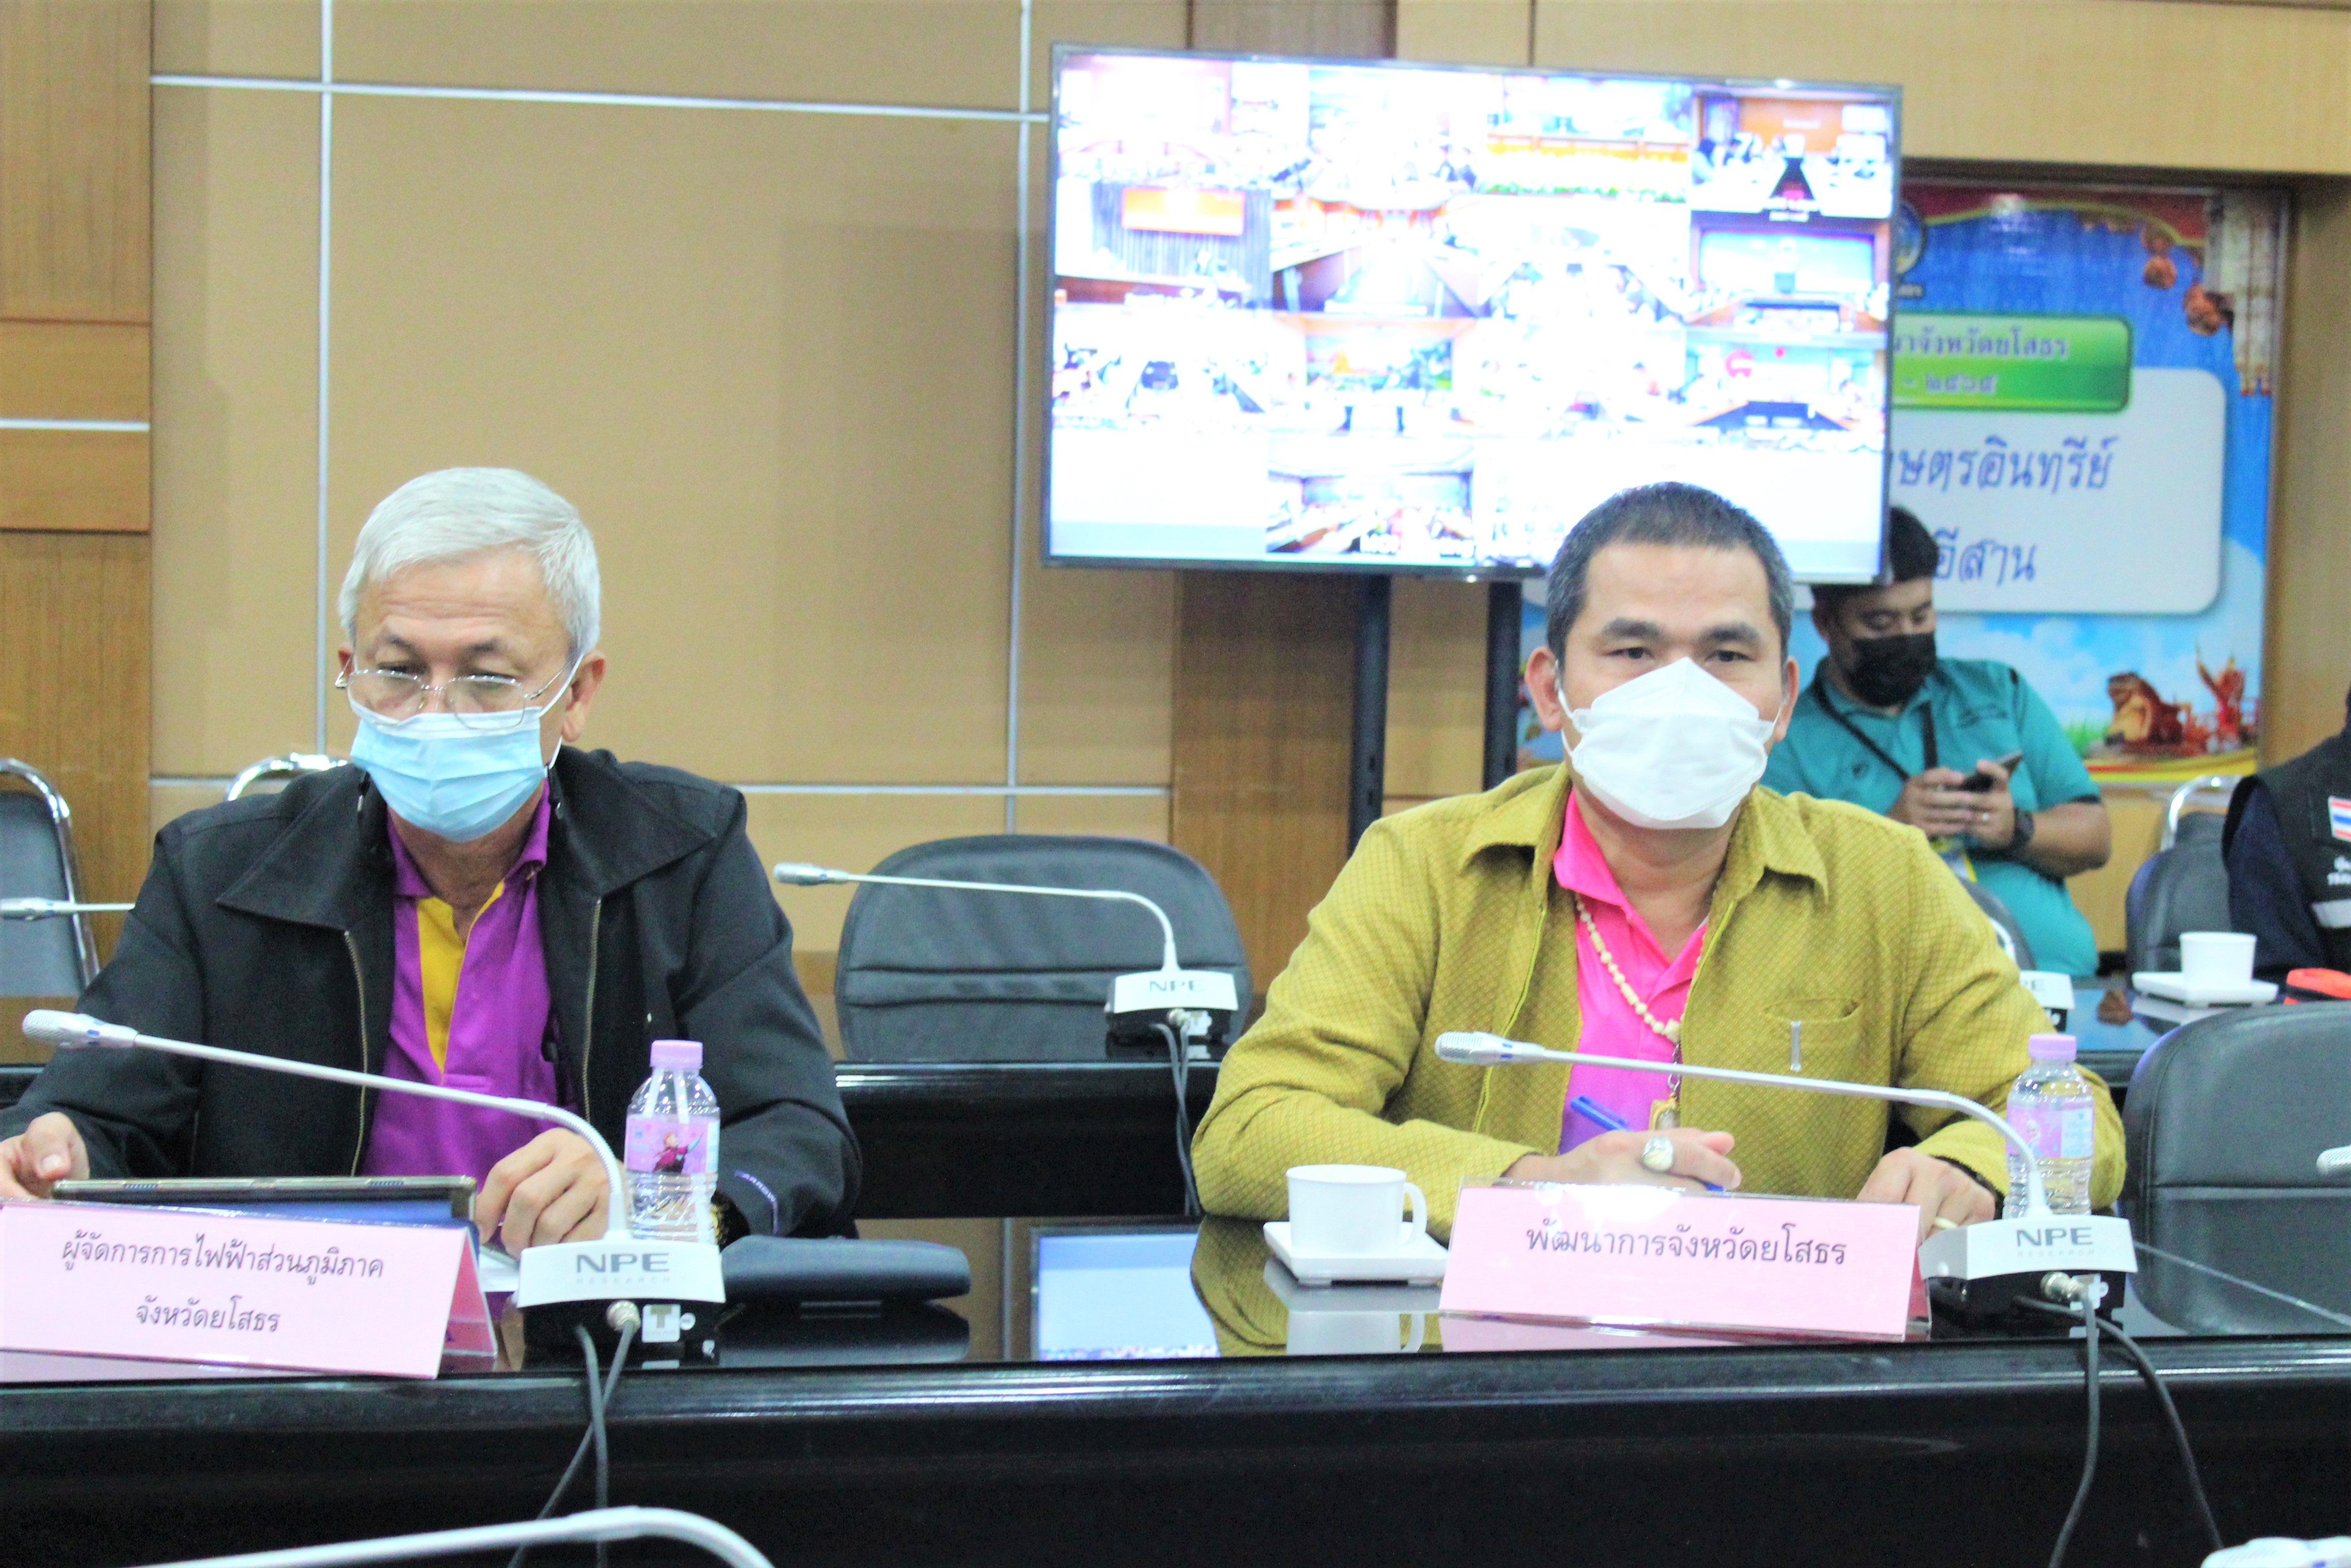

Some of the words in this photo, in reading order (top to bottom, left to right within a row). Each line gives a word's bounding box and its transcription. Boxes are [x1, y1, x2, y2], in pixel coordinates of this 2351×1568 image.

[1890, 435, 2119, 494] ษตรอินทรีย์
[1150, 980, 1203, 991] NPE
[1527, 1218, 1846, 1264] พัฒนาการจังหวัดยโสธร
[2016, 1227, 2093, 1246] NPE
[62, 1229, 383, 1284] ผู้จัดการการไฟฟ้าส่วนภูมิภาค
[577, 1253, 669, 1272] NPE
[137, 1295, 280, 1332] จังหวัดยโสธร
